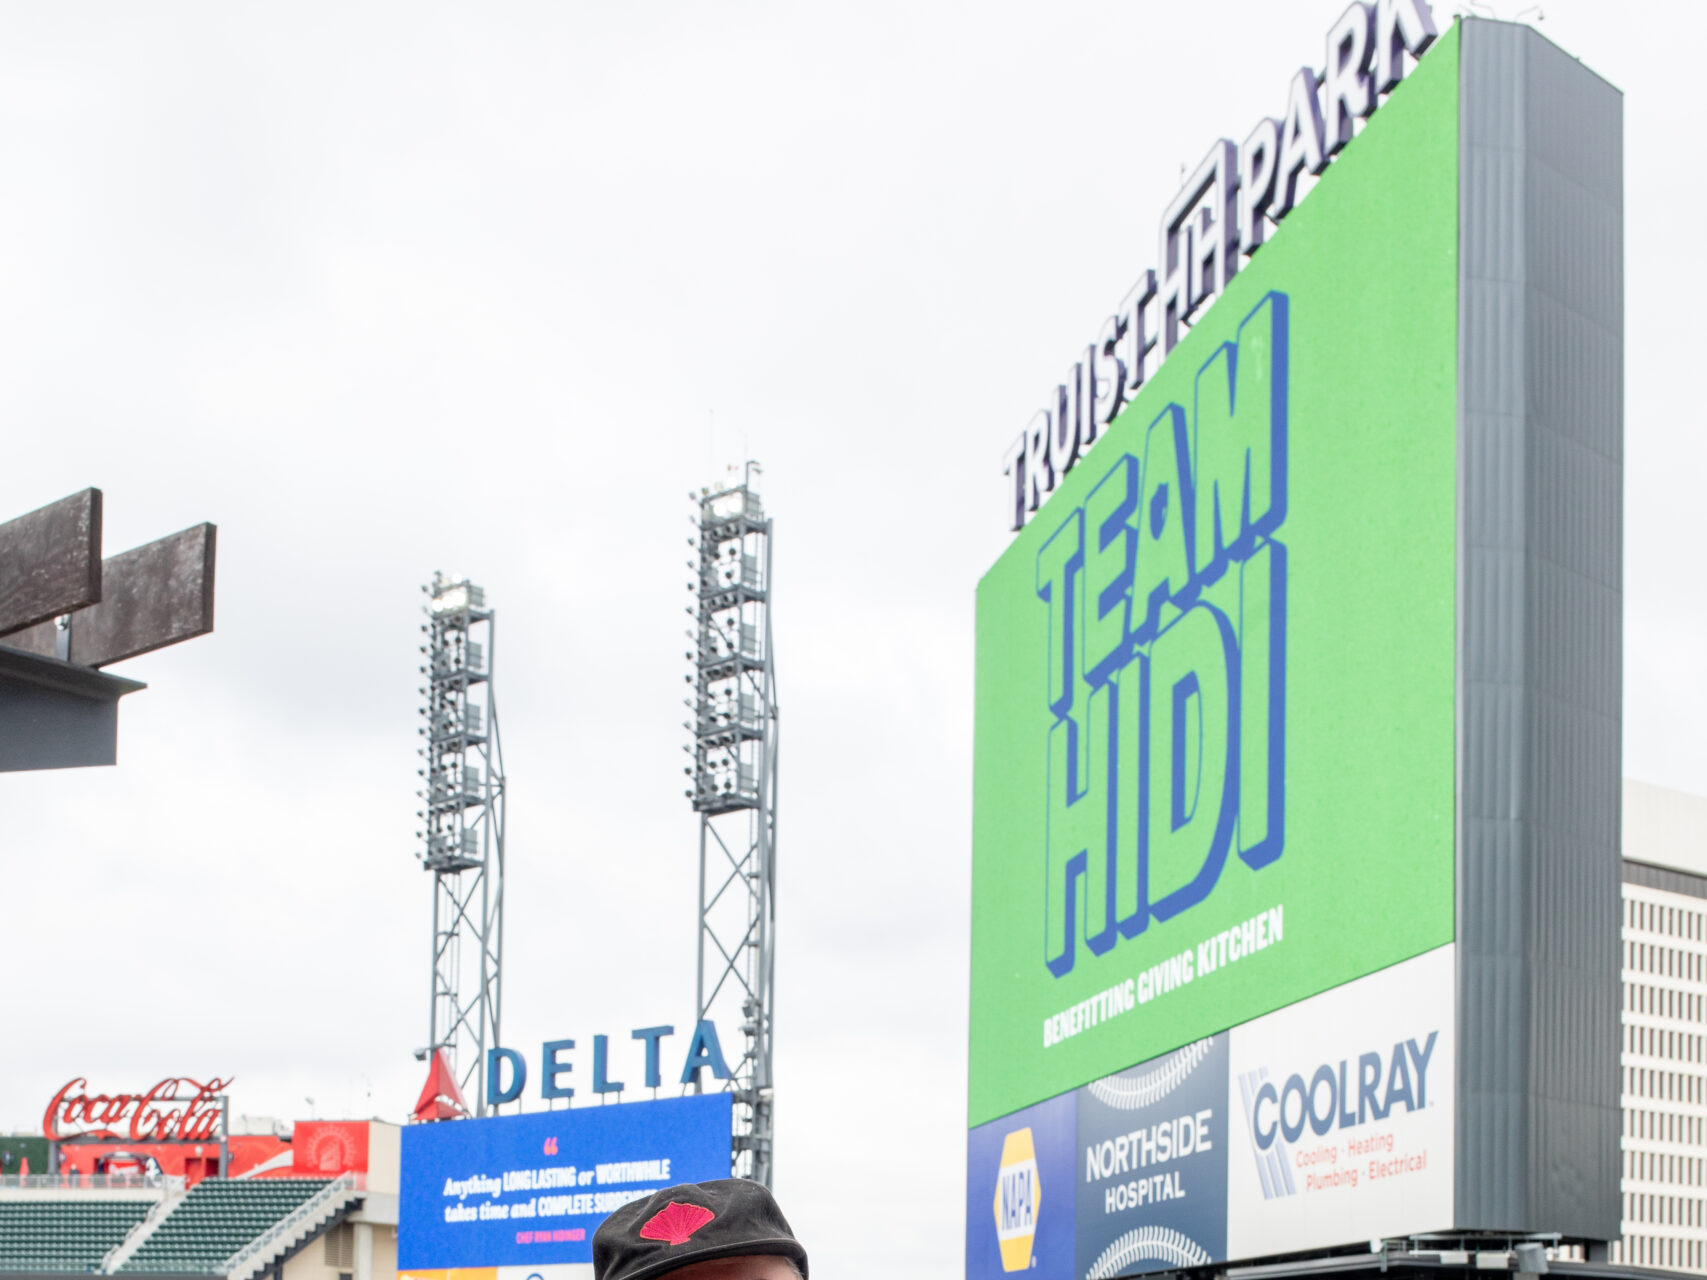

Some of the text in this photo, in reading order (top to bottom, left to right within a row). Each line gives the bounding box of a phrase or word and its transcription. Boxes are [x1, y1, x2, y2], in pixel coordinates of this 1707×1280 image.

[1002, 0, 1437, 531] TRUIST PARK
[1037, 290, 1289, 716] TEAM
[1045, 534, 1289, 979] HIDI
[1043, 904, 1284, 1049] BENEFITTING GIVING KITCHEN
[487, 1019, 732, 1105] DELTA
[1253, 1029, 1440, 1151] COOLRAY
[443, 1174, 501, 1200] Anything
[578, 1170, 595, 1187] or
[595, 1158, 672, 1185] WORTHWHILE
[1085, 1108, 1213, 1184] NORTHSIDE
[1296, 1132, 1395, 1169] Cooling Heating
[1305, 1149, 1428, 1192] Plumbing Electrical
[445, 1203, 478, 1222] takes
[479, 1201, 509, 1220] time
[510, 1198, 536, 1218] and
[538, 1193, 594, 1217] COMPLETE
[1002, 1167, 1034, 1232] NAPA
[1105, 1171, 1186, 1215] HOSPITAL
